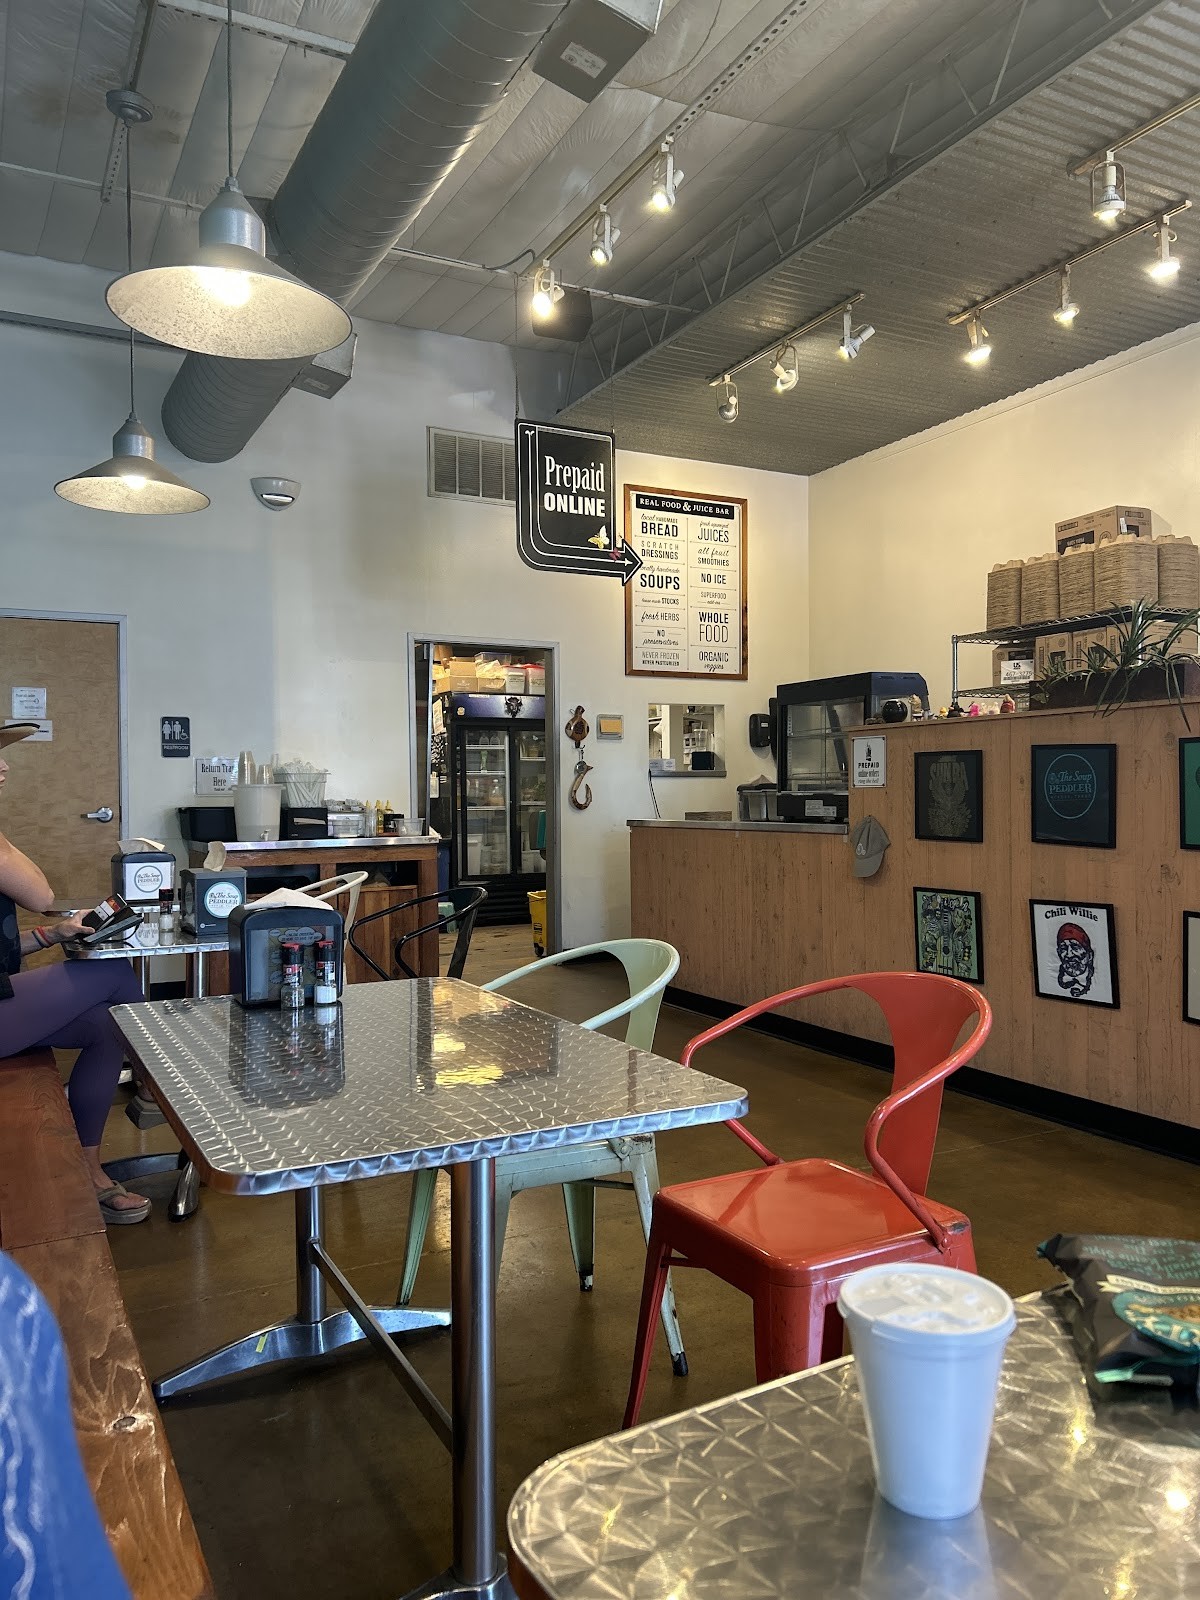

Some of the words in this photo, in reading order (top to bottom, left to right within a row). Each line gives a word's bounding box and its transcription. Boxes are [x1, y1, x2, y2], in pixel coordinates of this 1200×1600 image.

[544, 455, 606, 494] Prepaid
[544, 492, 606, 518] ONLINE
[639, 497, 660, 507] REAL
[661, 500, 682, 509] FOOD
[682, 501, 692, 512] &
[692, 504, 714, 513] JUICE
[715, 507, 730, 515] BAR
[640, 513, 656, 521] local
[641, 521, 679, 538] BREAD
[697, 528, 730, 543] JUICES
[640, 540, 679, 551] SCRATCH
[641, 548, 679, 560] DRESSINGS
[697, 547, 709, 555] all
[710, 547, 730, 558] fruit
[697, 557, 730, 567] SMOOTHIES
[640, 573, 680, 591] SOUPS
[700, 573, 712, 583] NO
[714, 574, 727, 585] ICE
[661, 597, 680, 606] STOCKS
[700, 591, 727, 600] SUPERFOOD
[640, 610, 660, 623] fresh
[660, 612, 680, 622] HERBS
[698, 611, 729, 624] WHOLE
[656, 629, 666, 637] NO
[699, 624, 729, 643] FOOD
[641, 651, 659, 659] NEVER
[659, 652, 680, 660] FROZEN
[698, 650, 729, 663] ORGANIC
[201, 763, 221, 773] Return
[212, 776, 227, 787] Here
[1057, 770, 1073, 782] The
[1072, 770, 1092, 783] Soup
[1048, 783, 1092, 795] PEDDLER
[216, 891, 226, 899] The
[226, 892, 239, 900] Soup
[1044, 907, 1067, 920] Chili
[1068, 905, 1099, 922] Willie
